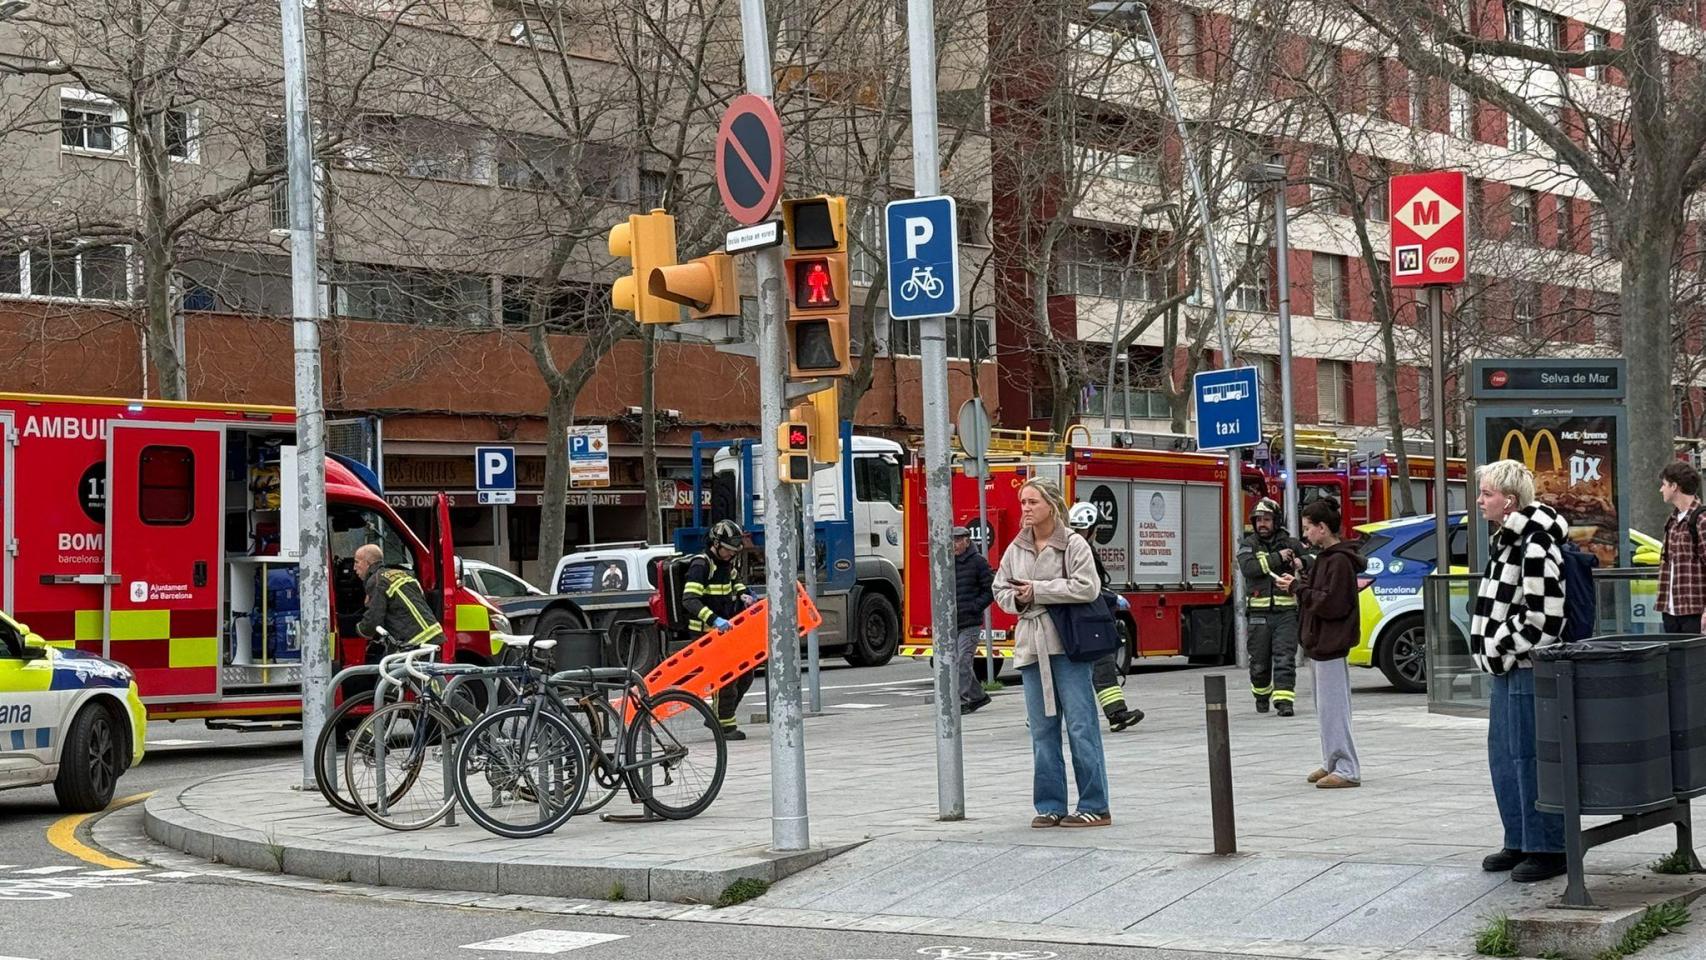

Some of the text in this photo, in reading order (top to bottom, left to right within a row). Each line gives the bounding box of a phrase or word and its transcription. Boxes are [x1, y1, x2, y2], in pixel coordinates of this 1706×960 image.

[1413, 200, 1440, 226] M
[905, 216, 934, 259] P
[1433, 255, 1455, 265] TMB
[1541, 373, 1610, 384] Selva de Mar
[23, 415, 107, 440] AMBUL
[1215, 419, 1240, 435] taxi
[573, 437, 585, 452] P
[484, 452, 508, 485] P
[386, 495, 456, 507] LOS TONS
[58, 533, 103, 551] BOM
[150, 584, 188, 592] Ajuntament
[1374, 585, 1416, 595] Barcelona
[150, 592, 193, 600] de Barcelona
[0, 703, 32, 723] ana
